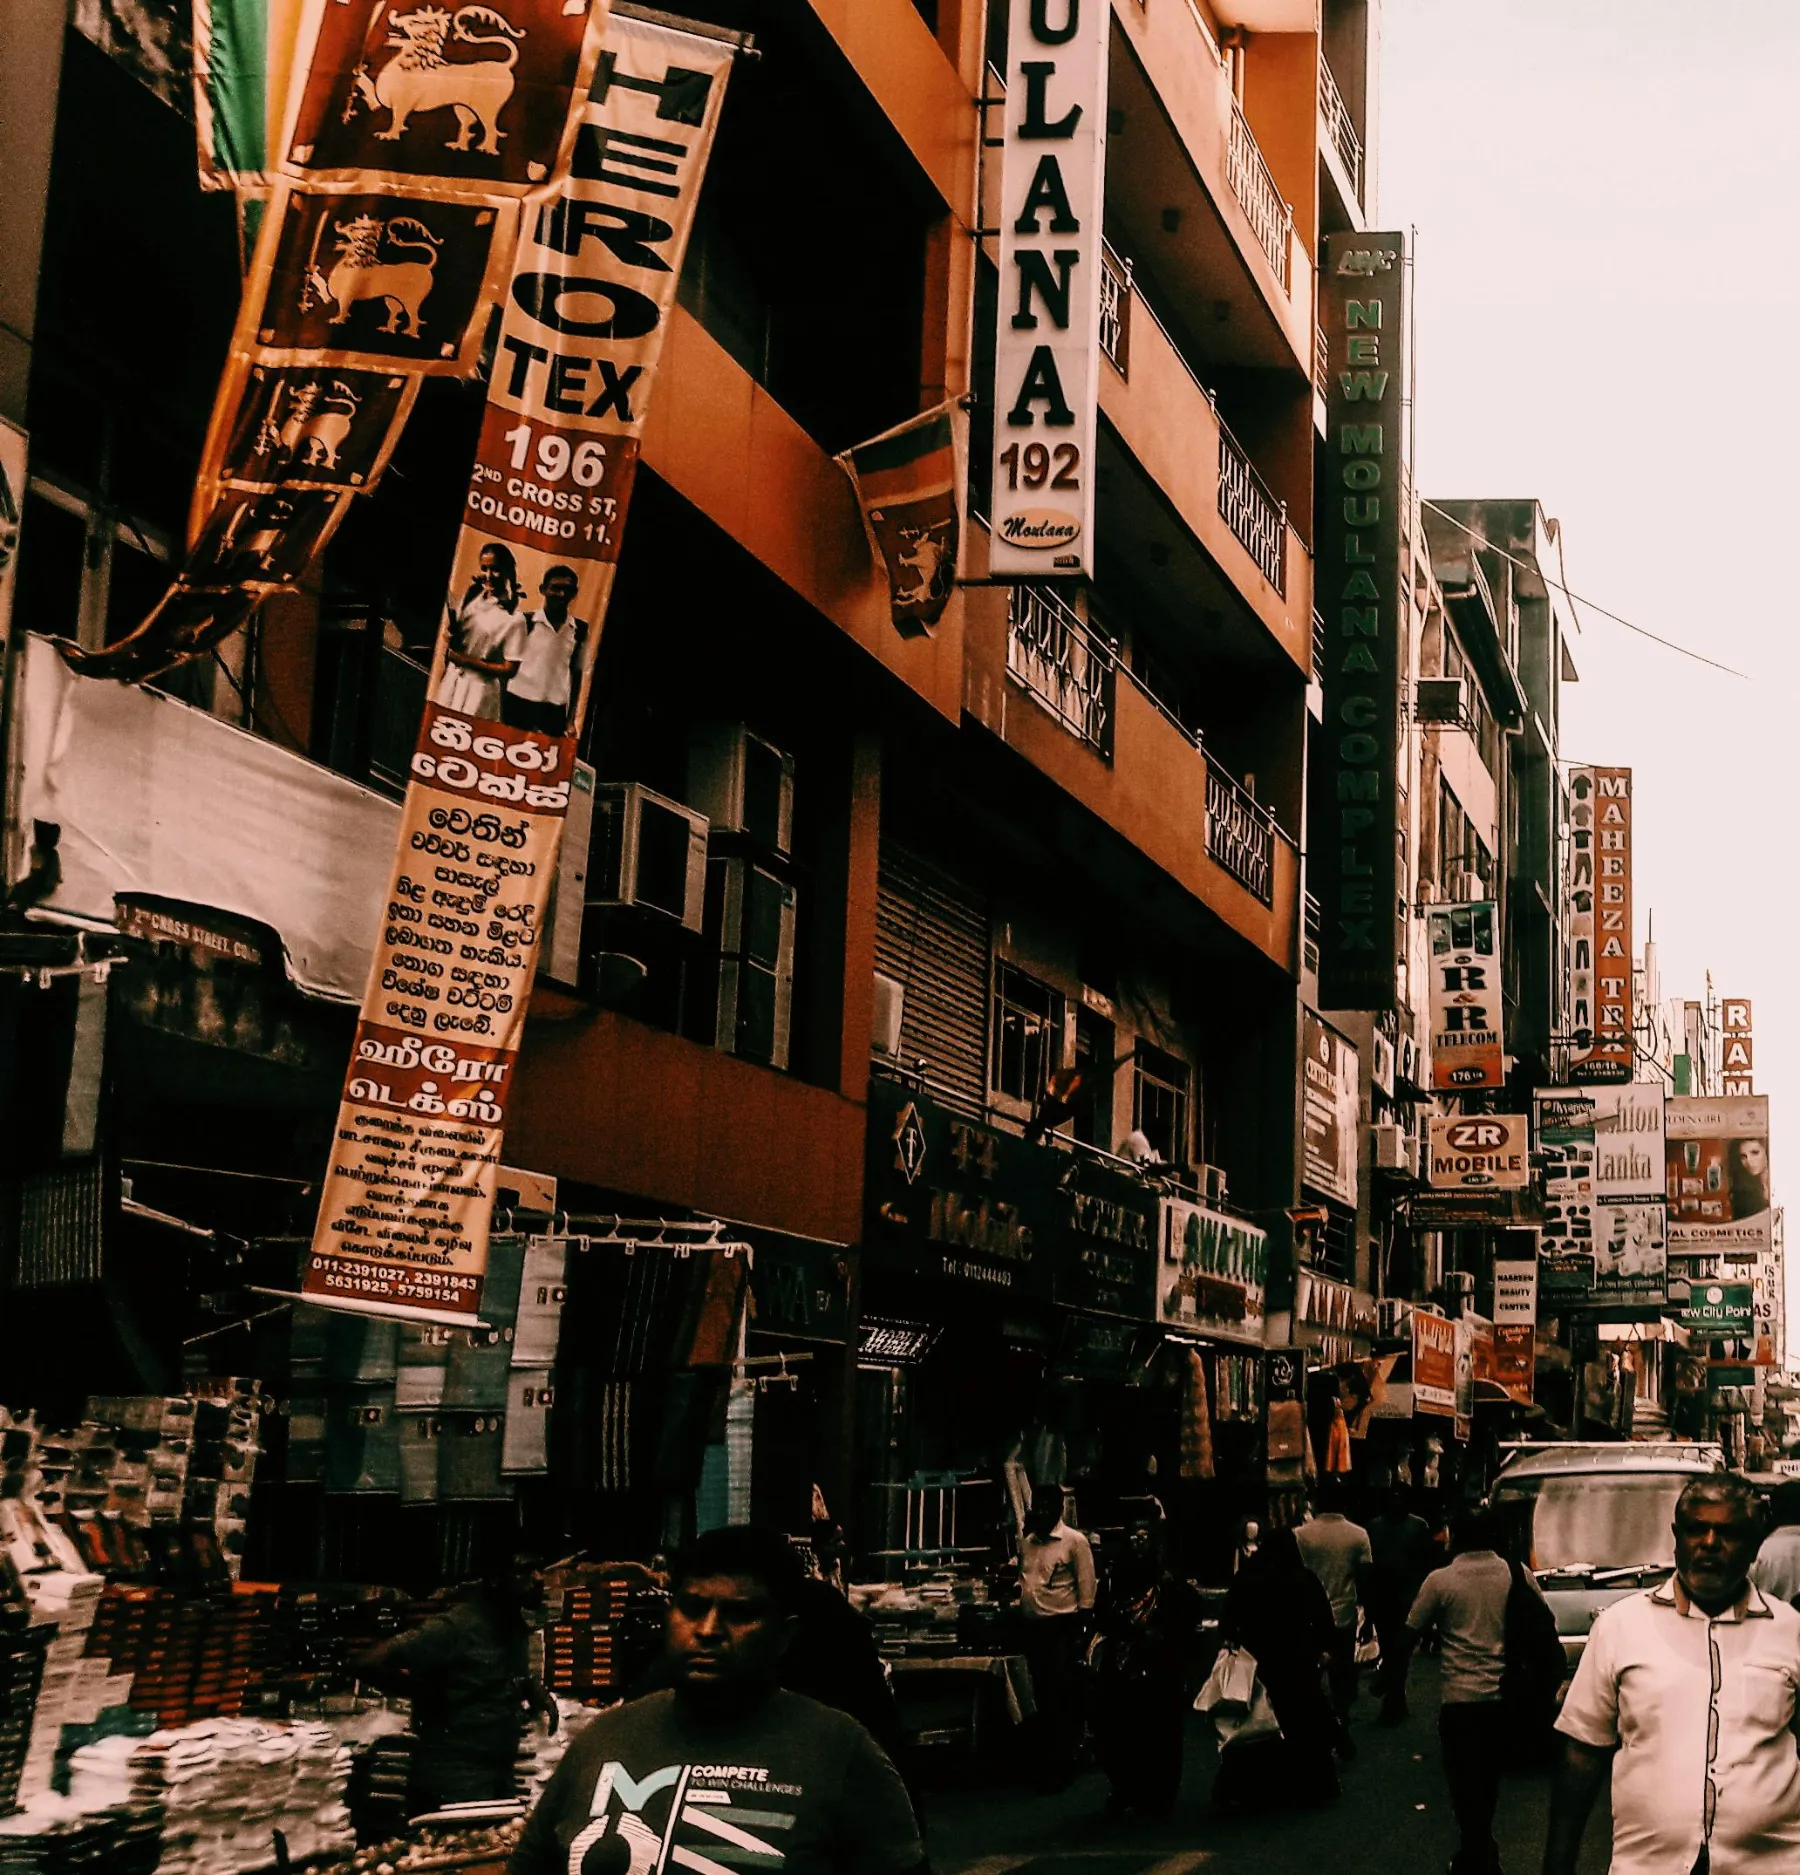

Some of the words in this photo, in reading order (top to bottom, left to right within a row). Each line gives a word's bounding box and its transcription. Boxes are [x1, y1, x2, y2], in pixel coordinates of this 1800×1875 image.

[512, 49, 714, 340] HERO
[1339, 299, 1389, 402] NEW
[502, 340, 645, 423] TEX
[503, 424, 606, 488] 196
[1000, 442, 1080, 491] 192
[472, 463, 502, 484] 2ND
[507, 478, 582, 512] CROSS
[468, 490, 576, 540] COLOMBO
[1003, 517, 1074, 538] Moulana
[1340, 424, 1385, 673] MOULANA
[1337, 696, 1380, 950] COMPLEX
[1598, 776, 1629, 957] MAHEEZA
[1441, 967, 1487, 992] R
[1442, 1006, 1488, 1031] R
[1601, 976, 1626, 1053] TEX
[1436, 1031, 1497, 1047] TELECOM
[1454, 1125, 1501, 1146] ZR
[1434, 1155, 1521, 1173] MOBILE
[1597, 1144, 1652, 1181] Lanka
[1691, 1229, 1764, 1238] COSMETICS
[397, 1283, 460, 1303] 5759154
[414, 1271, 477, 1292] 2391843
[691, 1765, 769, 1783] COMPETE
[731, 1780, 803, 1796] CHALLENGES
